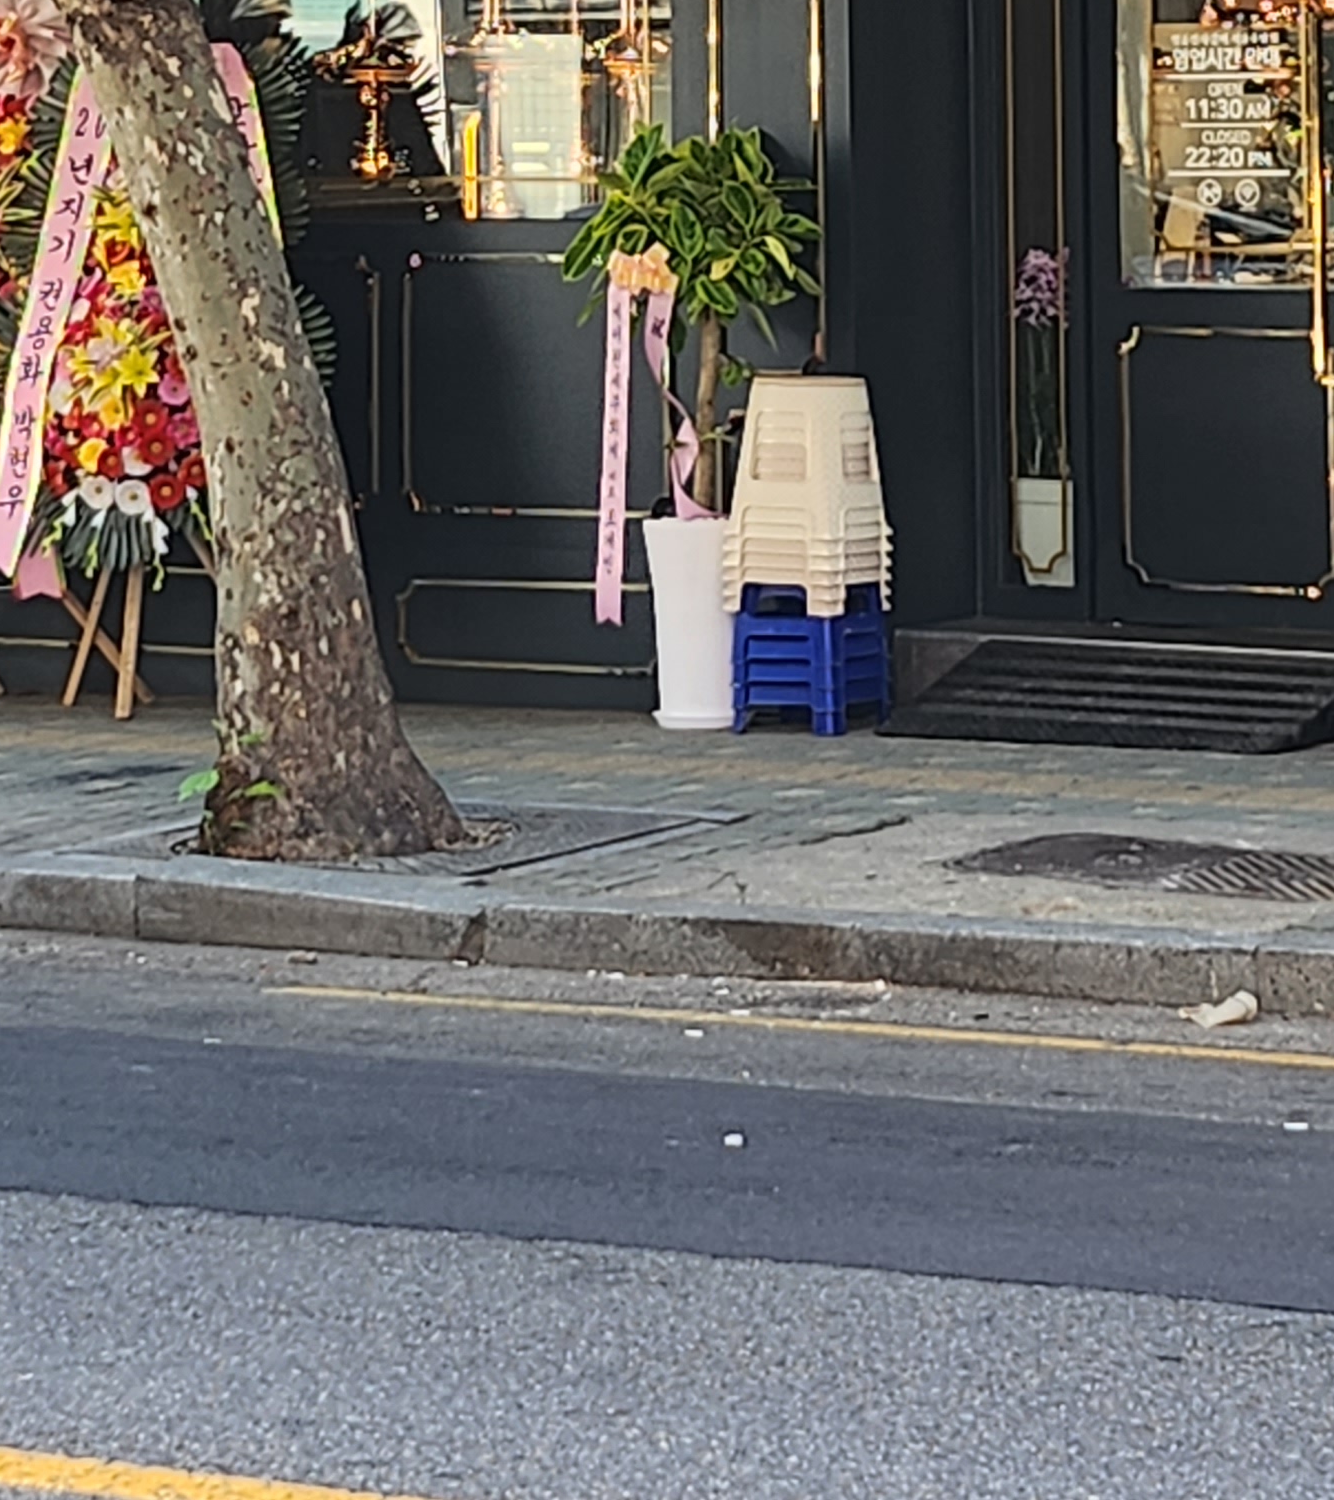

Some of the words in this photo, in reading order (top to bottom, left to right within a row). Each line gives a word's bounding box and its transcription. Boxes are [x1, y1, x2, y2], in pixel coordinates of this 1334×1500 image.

[1172, 46, 1243, 72] 영업시간
[1186, 98, 1243, 119] 11:30
[1245, 102, 1271, 119] AM
[1201, 130, 1251, 145] CLOSED
[1185, 147, 1244, 168] 22:20
